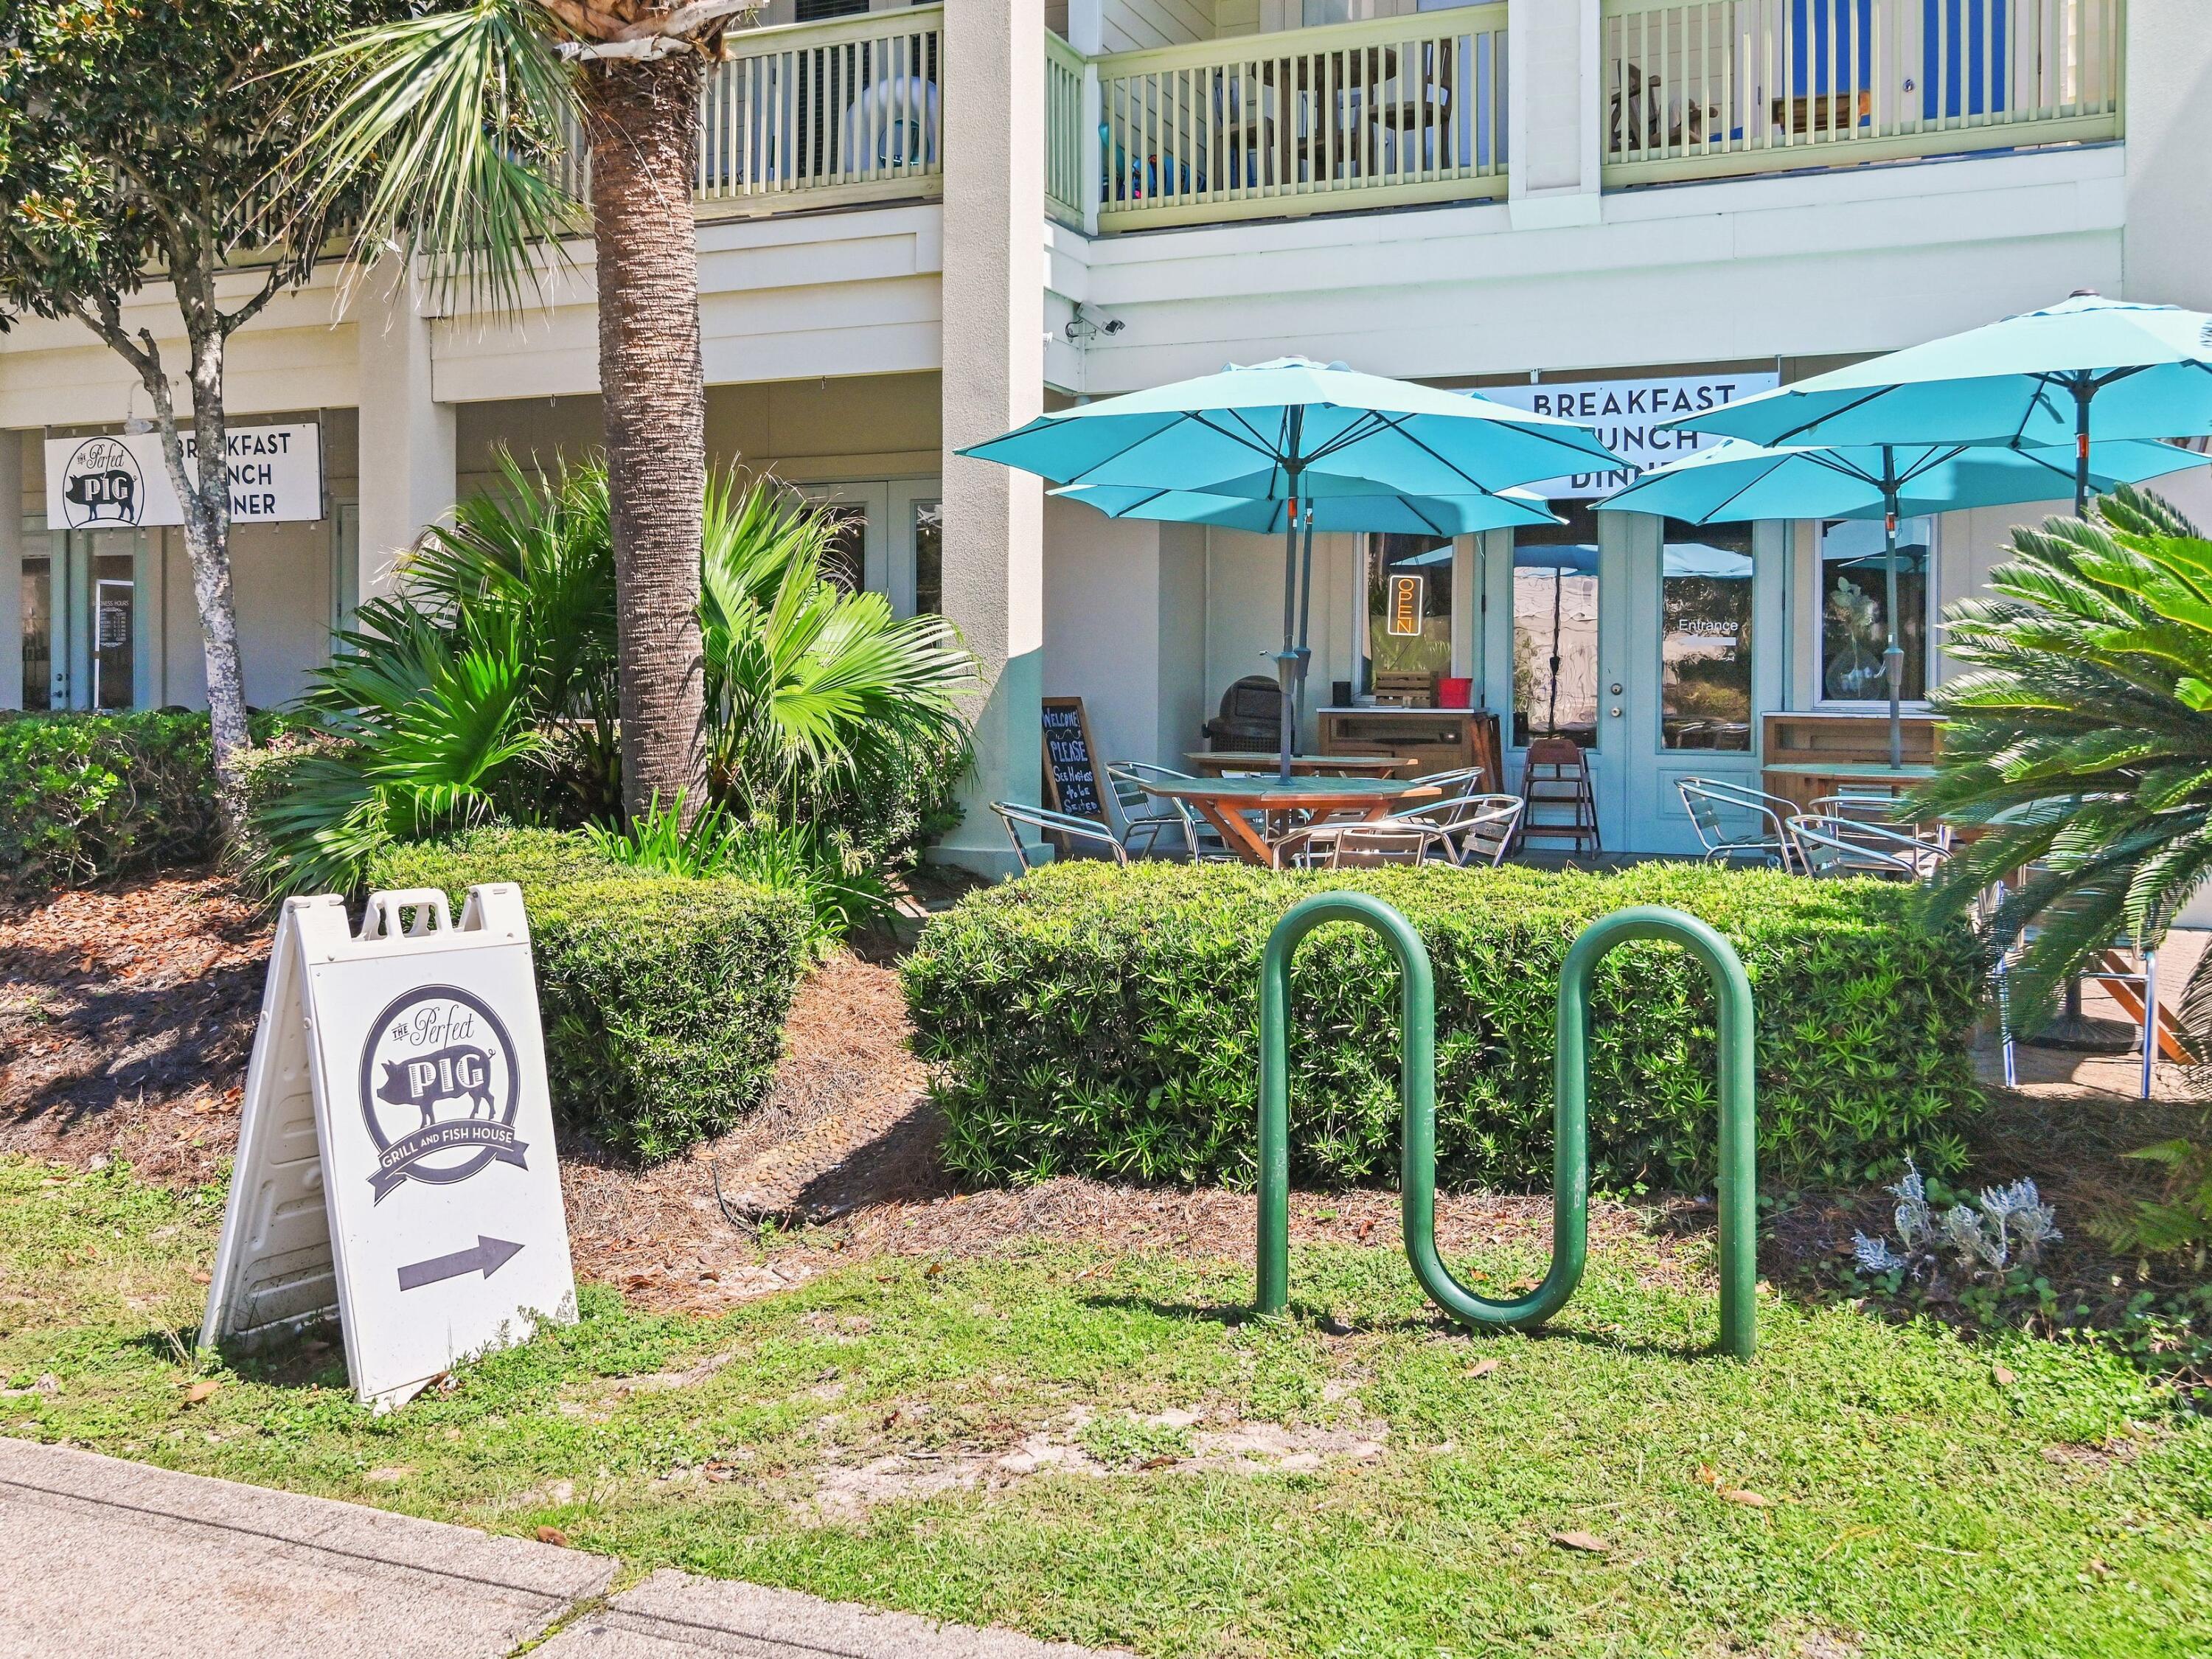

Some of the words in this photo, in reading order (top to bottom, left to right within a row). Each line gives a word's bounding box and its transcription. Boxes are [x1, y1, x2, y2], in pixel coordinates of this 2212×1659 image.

[1534, 385, 1735, 417] BREAKFAST
[1598, 425, 1697, 451] UNCH
[86, 443, 124, 479] Perfect
[227, 464, 271, 486] NCH
[85, 477, 128, 501] PIG
[1397, 578, 1414, 633] OPEN
[1679, 619, 1739, 631] Entrance
[1050, 740, 1088, 762] PLEASE
[392, 1026, 408, 1038] THE
[410, 1004, 474, 1048] Perfect
[408, 1054, 484, 1098] PIG
[382, 1142, 418, 1168] GRILL
[421, 1134, 439, 1147] AND
[442, 1127, 469, 1142] FISH
[473, 1127, 513, 1143] HOUSE
